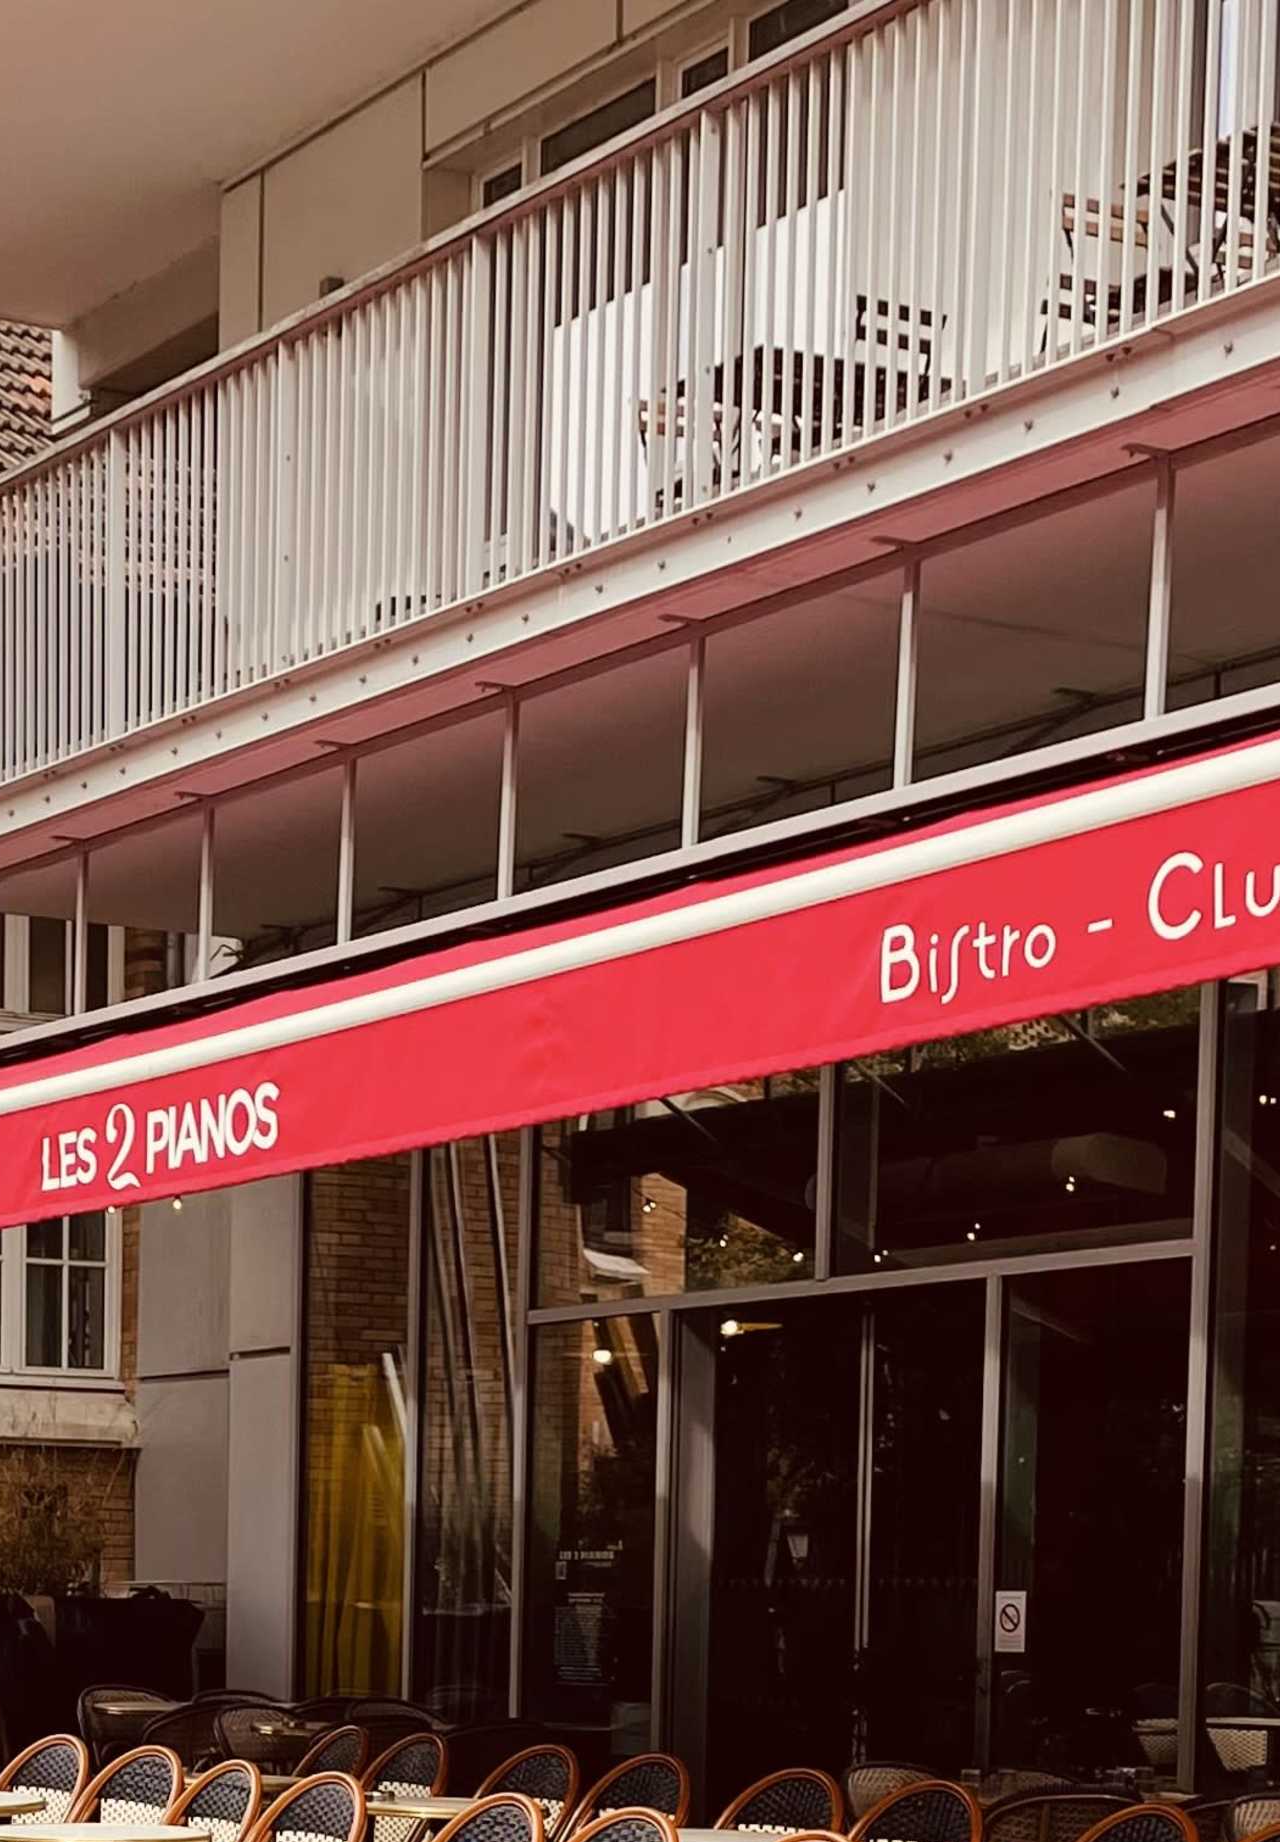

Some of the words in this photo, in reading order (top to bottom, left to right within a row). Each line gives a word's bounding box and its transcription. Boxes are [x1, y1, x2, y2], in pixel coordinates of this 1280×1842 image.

[880, 921, 1057, 1004] Bistro
[41, 1126, 98, 1192] LES
[104, 1103, 141, 1190] 2
[145, 1081, 280, 1175] PIANOS
